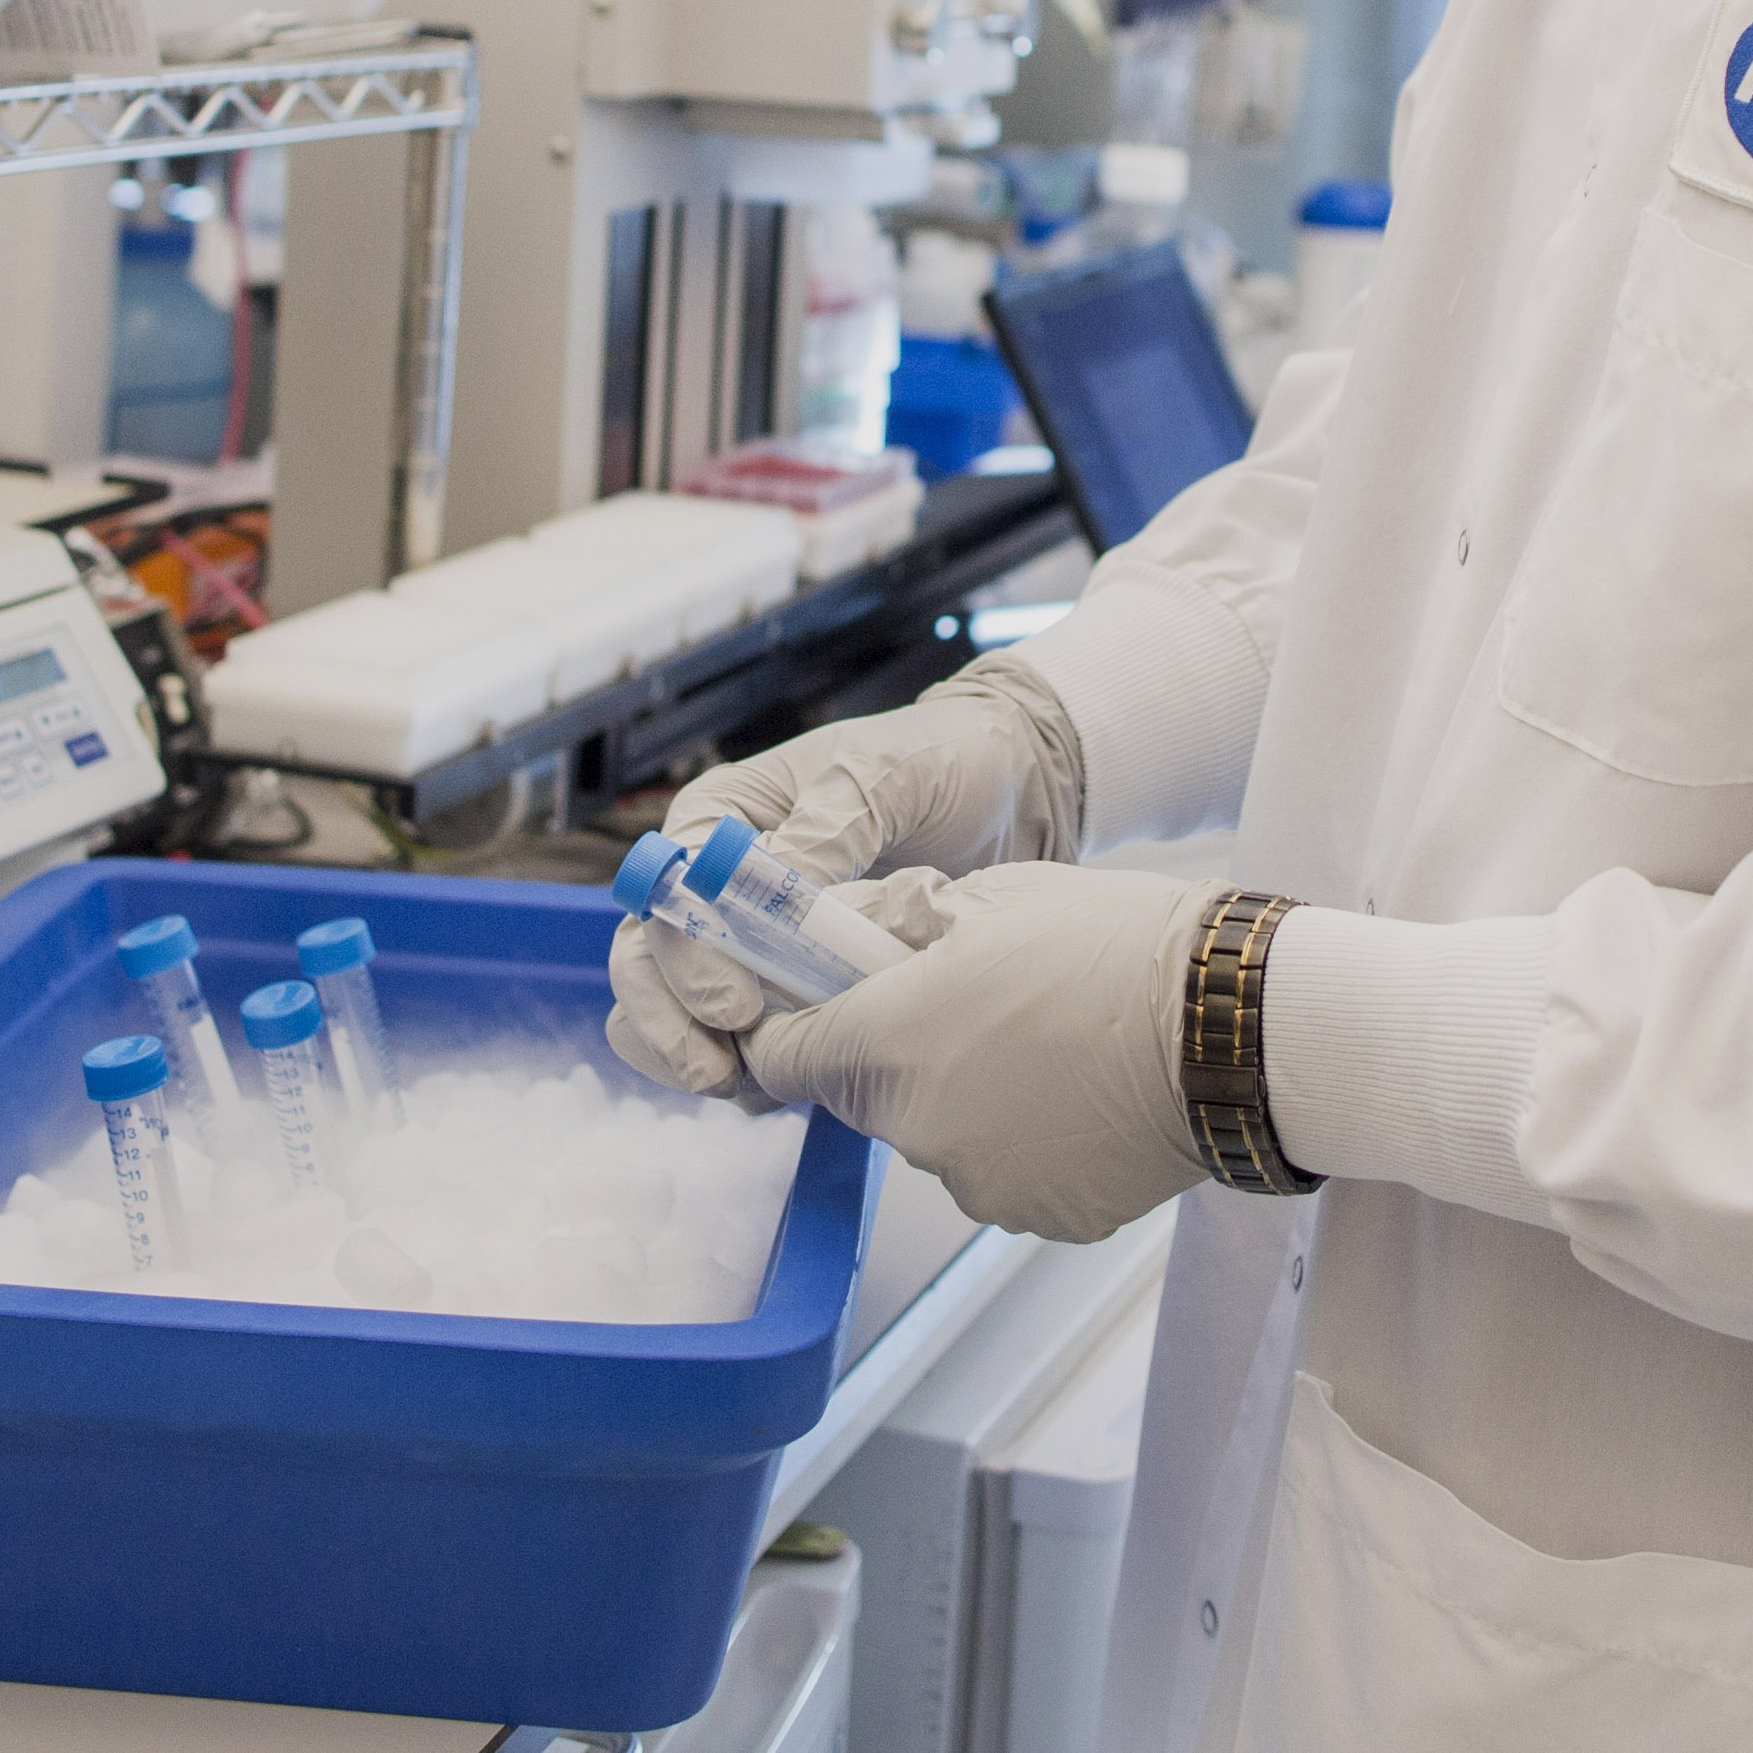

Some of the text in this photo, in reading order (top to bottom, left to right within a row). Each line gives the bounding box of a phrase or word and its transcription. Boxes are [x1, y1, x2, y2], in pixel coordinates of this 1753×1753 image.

[764, 868, 800, 917] FALCO
[119, 1127, 137, 1140] 13
[123, 1148, 141, 1161] 12
[132, 1190, 149, 1203] 10
